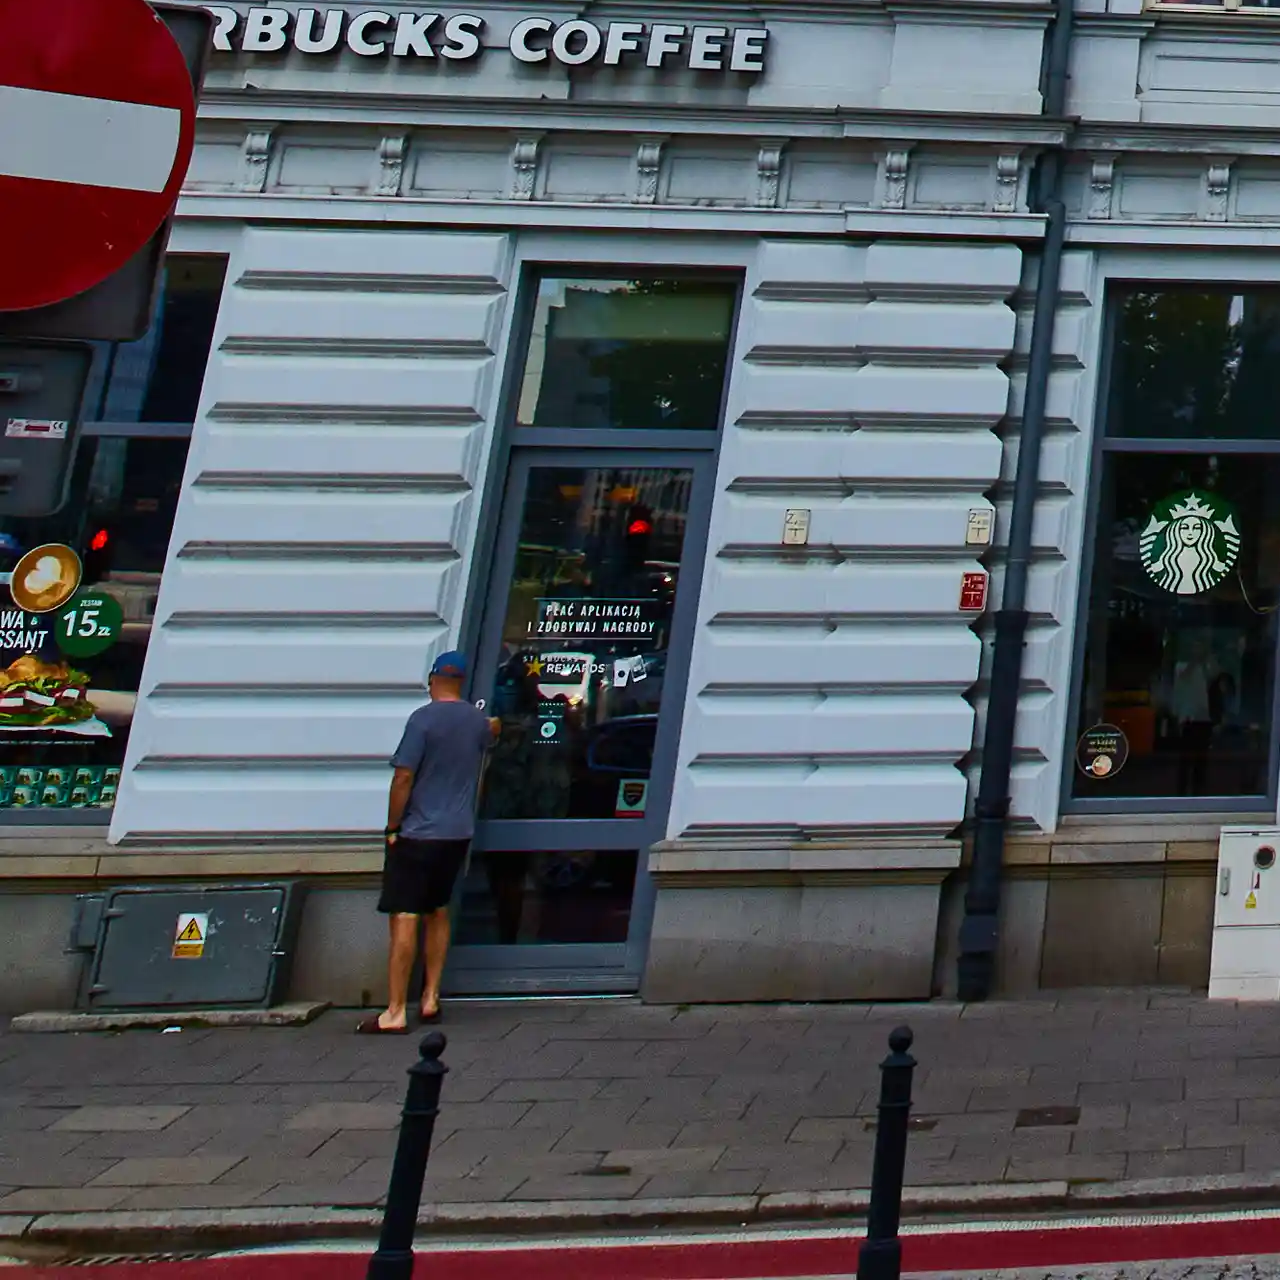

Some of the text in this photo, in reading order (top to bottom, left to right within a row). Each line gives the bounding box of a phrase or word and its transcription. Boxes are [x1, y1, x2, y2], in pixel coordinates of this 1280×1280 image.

[509, 16, 769, 72] COFFEE
[546, 603, 641, 618] PŁAĆ APLIKACJĄ
[537, 621, 597, 633] ZDOBYWAJ
[602, 621, 656, 633] NAGRODY
[546, 664, 607, 674] REWARDS
